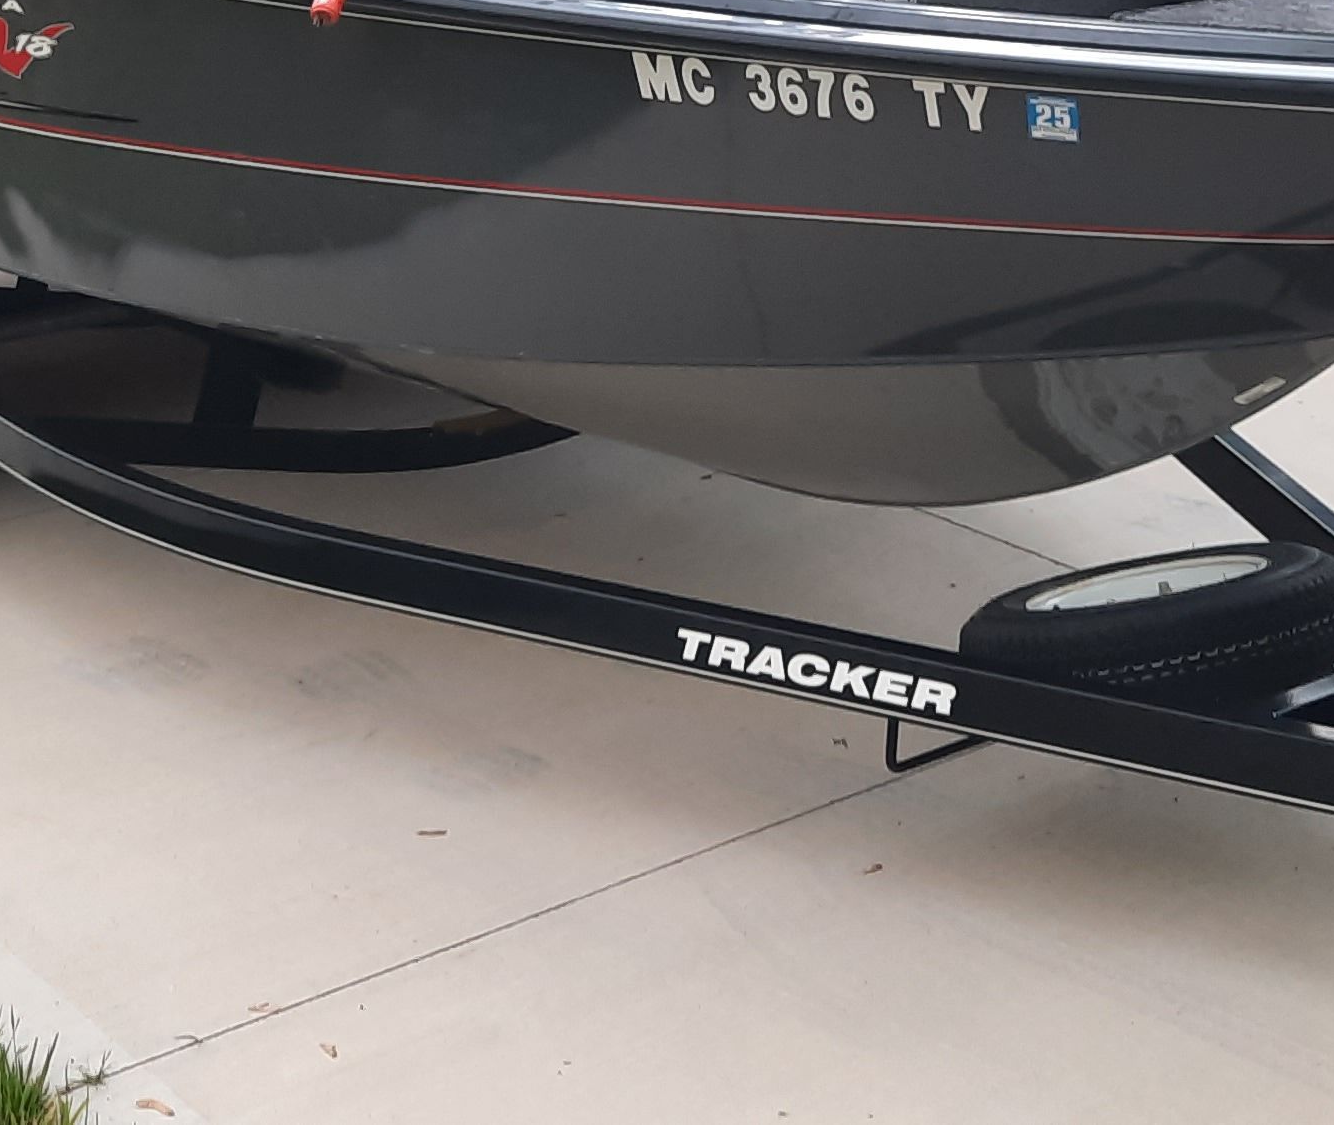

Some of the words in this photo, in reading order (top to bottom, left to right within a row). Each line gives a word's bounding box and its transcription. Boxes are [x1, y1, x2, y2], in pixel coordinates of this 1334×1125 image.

[631, 51, 715, 106] MC
[746, 64, 876, 122] 3676
[912, 80, 989, 133] TY
[1035, 104, 1071, 130] 25
[677, 627, 957, 715] TRACKER
